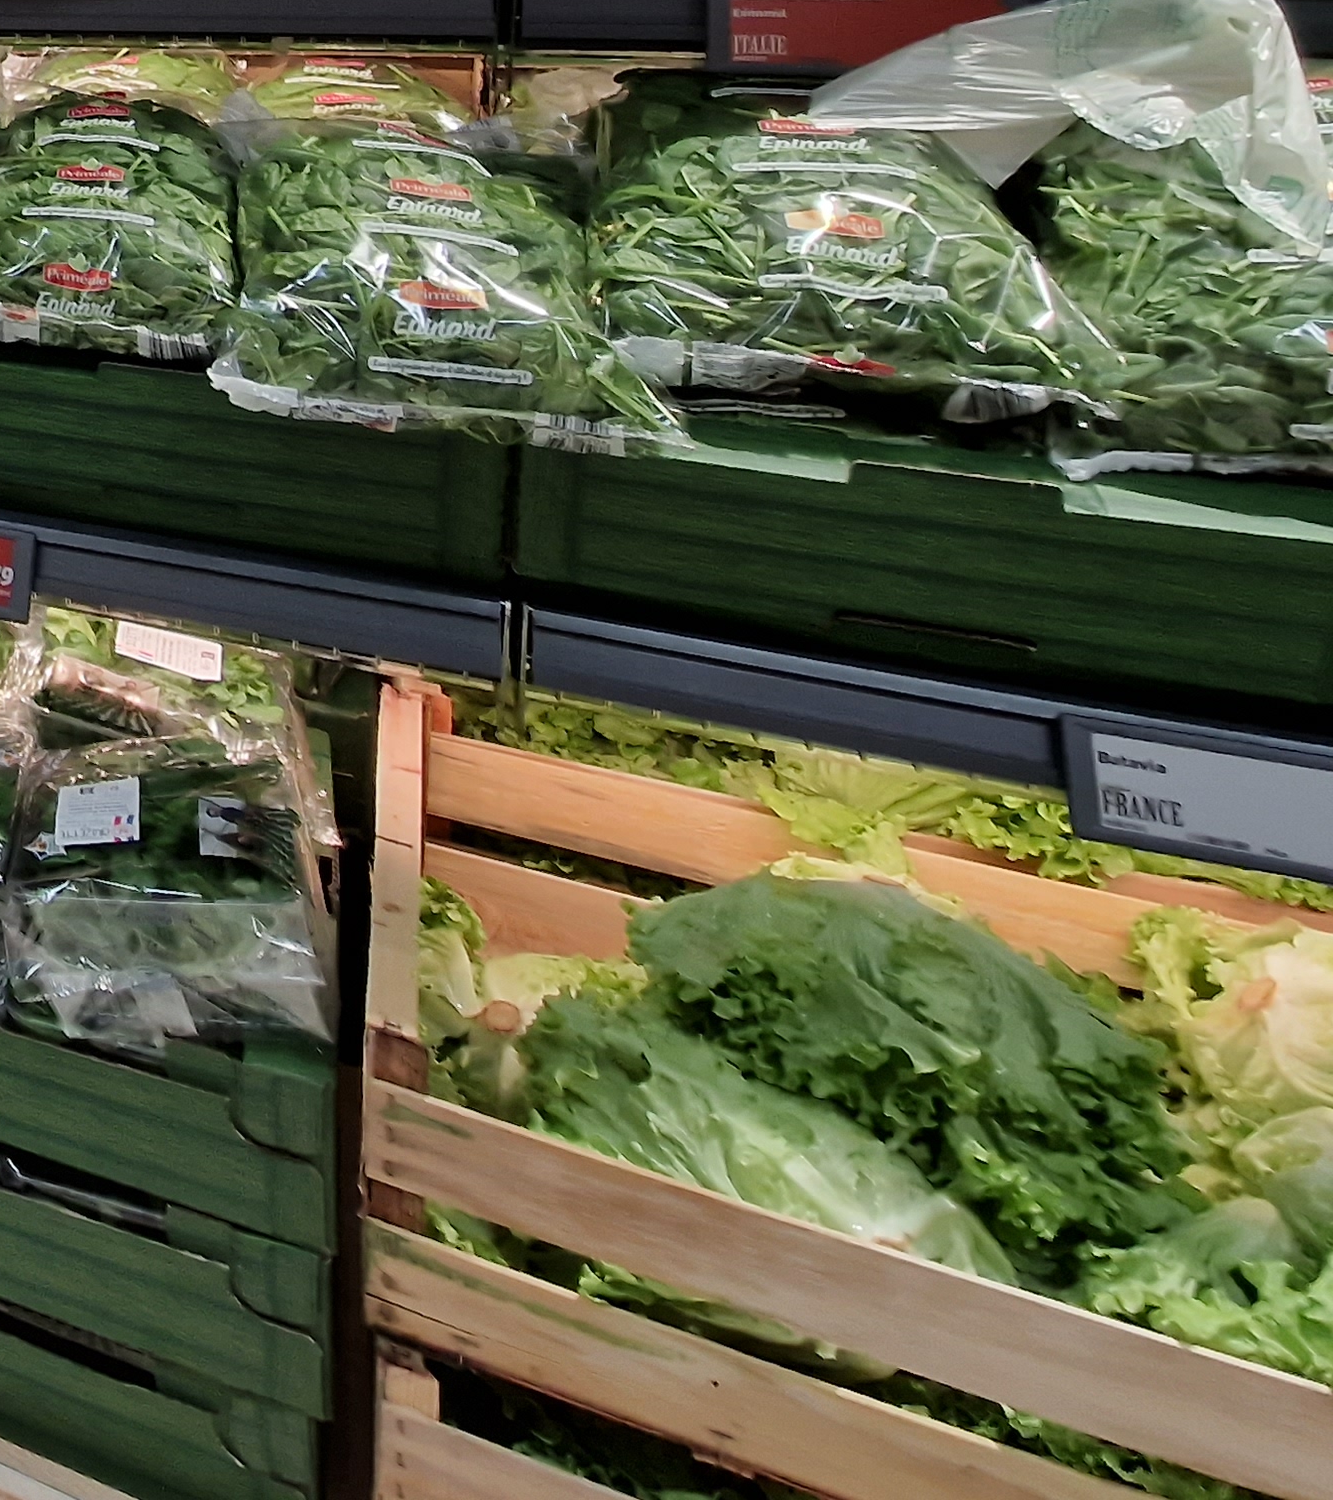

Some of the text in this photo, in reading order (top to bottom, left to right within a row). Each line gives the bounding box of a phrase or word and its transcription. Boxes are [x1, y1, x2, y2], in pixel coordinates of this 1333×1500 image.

[733, 34, 788, 55] ITALIE
[759, 135, 871, 153] Epinard
[49, 182, 129, 200] Epinard
[387, 195, 483, 223] Epinard
[1102, 789, 1185, 827] FRANCE
